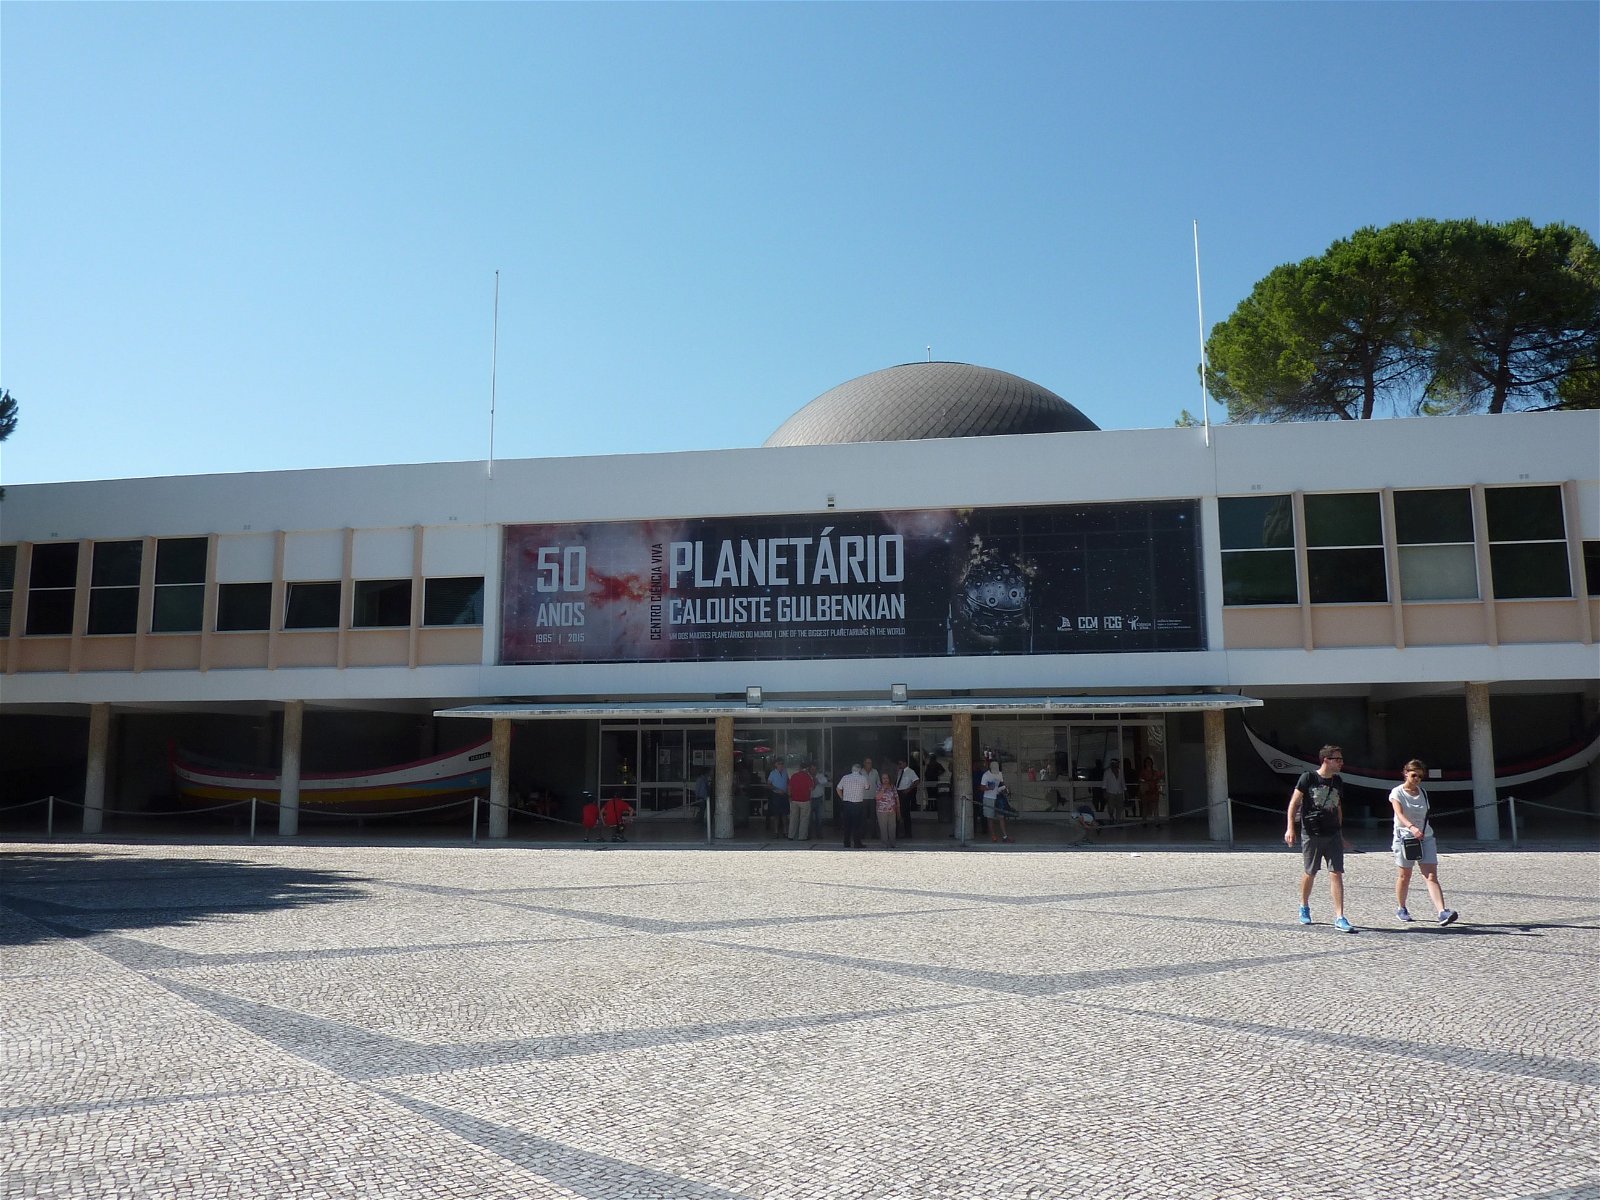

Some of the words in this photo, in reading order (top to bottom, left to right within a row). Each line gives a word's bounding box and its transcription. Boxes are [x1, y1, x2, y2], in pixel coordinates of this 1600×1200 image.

[651, 543, 663, 564] VIVA
[669, 526, 905, 589] PLANETÁRIO
[537, 545, 587, 593] 50
[650, 566, 662, 602] CIÊNCIA
[536, 602, 585, 627] ANOS
[650, 604, 662, 640] CENTRO
[669, 597, 772, 625] CALOUSTE
[777, 594, 905, 622] GULBENKIAN
[1077, 616, 1098, 629] CCM
[535, 633, 552, 644] 1965
[568, 632, 585, 643] 2015
[678, 632, 689, 640] DOS
[689, 631, 711, 639] MAIORES
[711, 630, 745, 639] PLANETÁRIOS
[745, 630, 753, 638] DO
[754, 630, 772, 638] MUNDO
[778, 630, 789, 638] ONE
[807, 629, 829, 637] BIGGEST
[870, 628, 875, 636] IN
[876, 628, 886, 636] THE
[887, 627, 906, 636] WORLD
